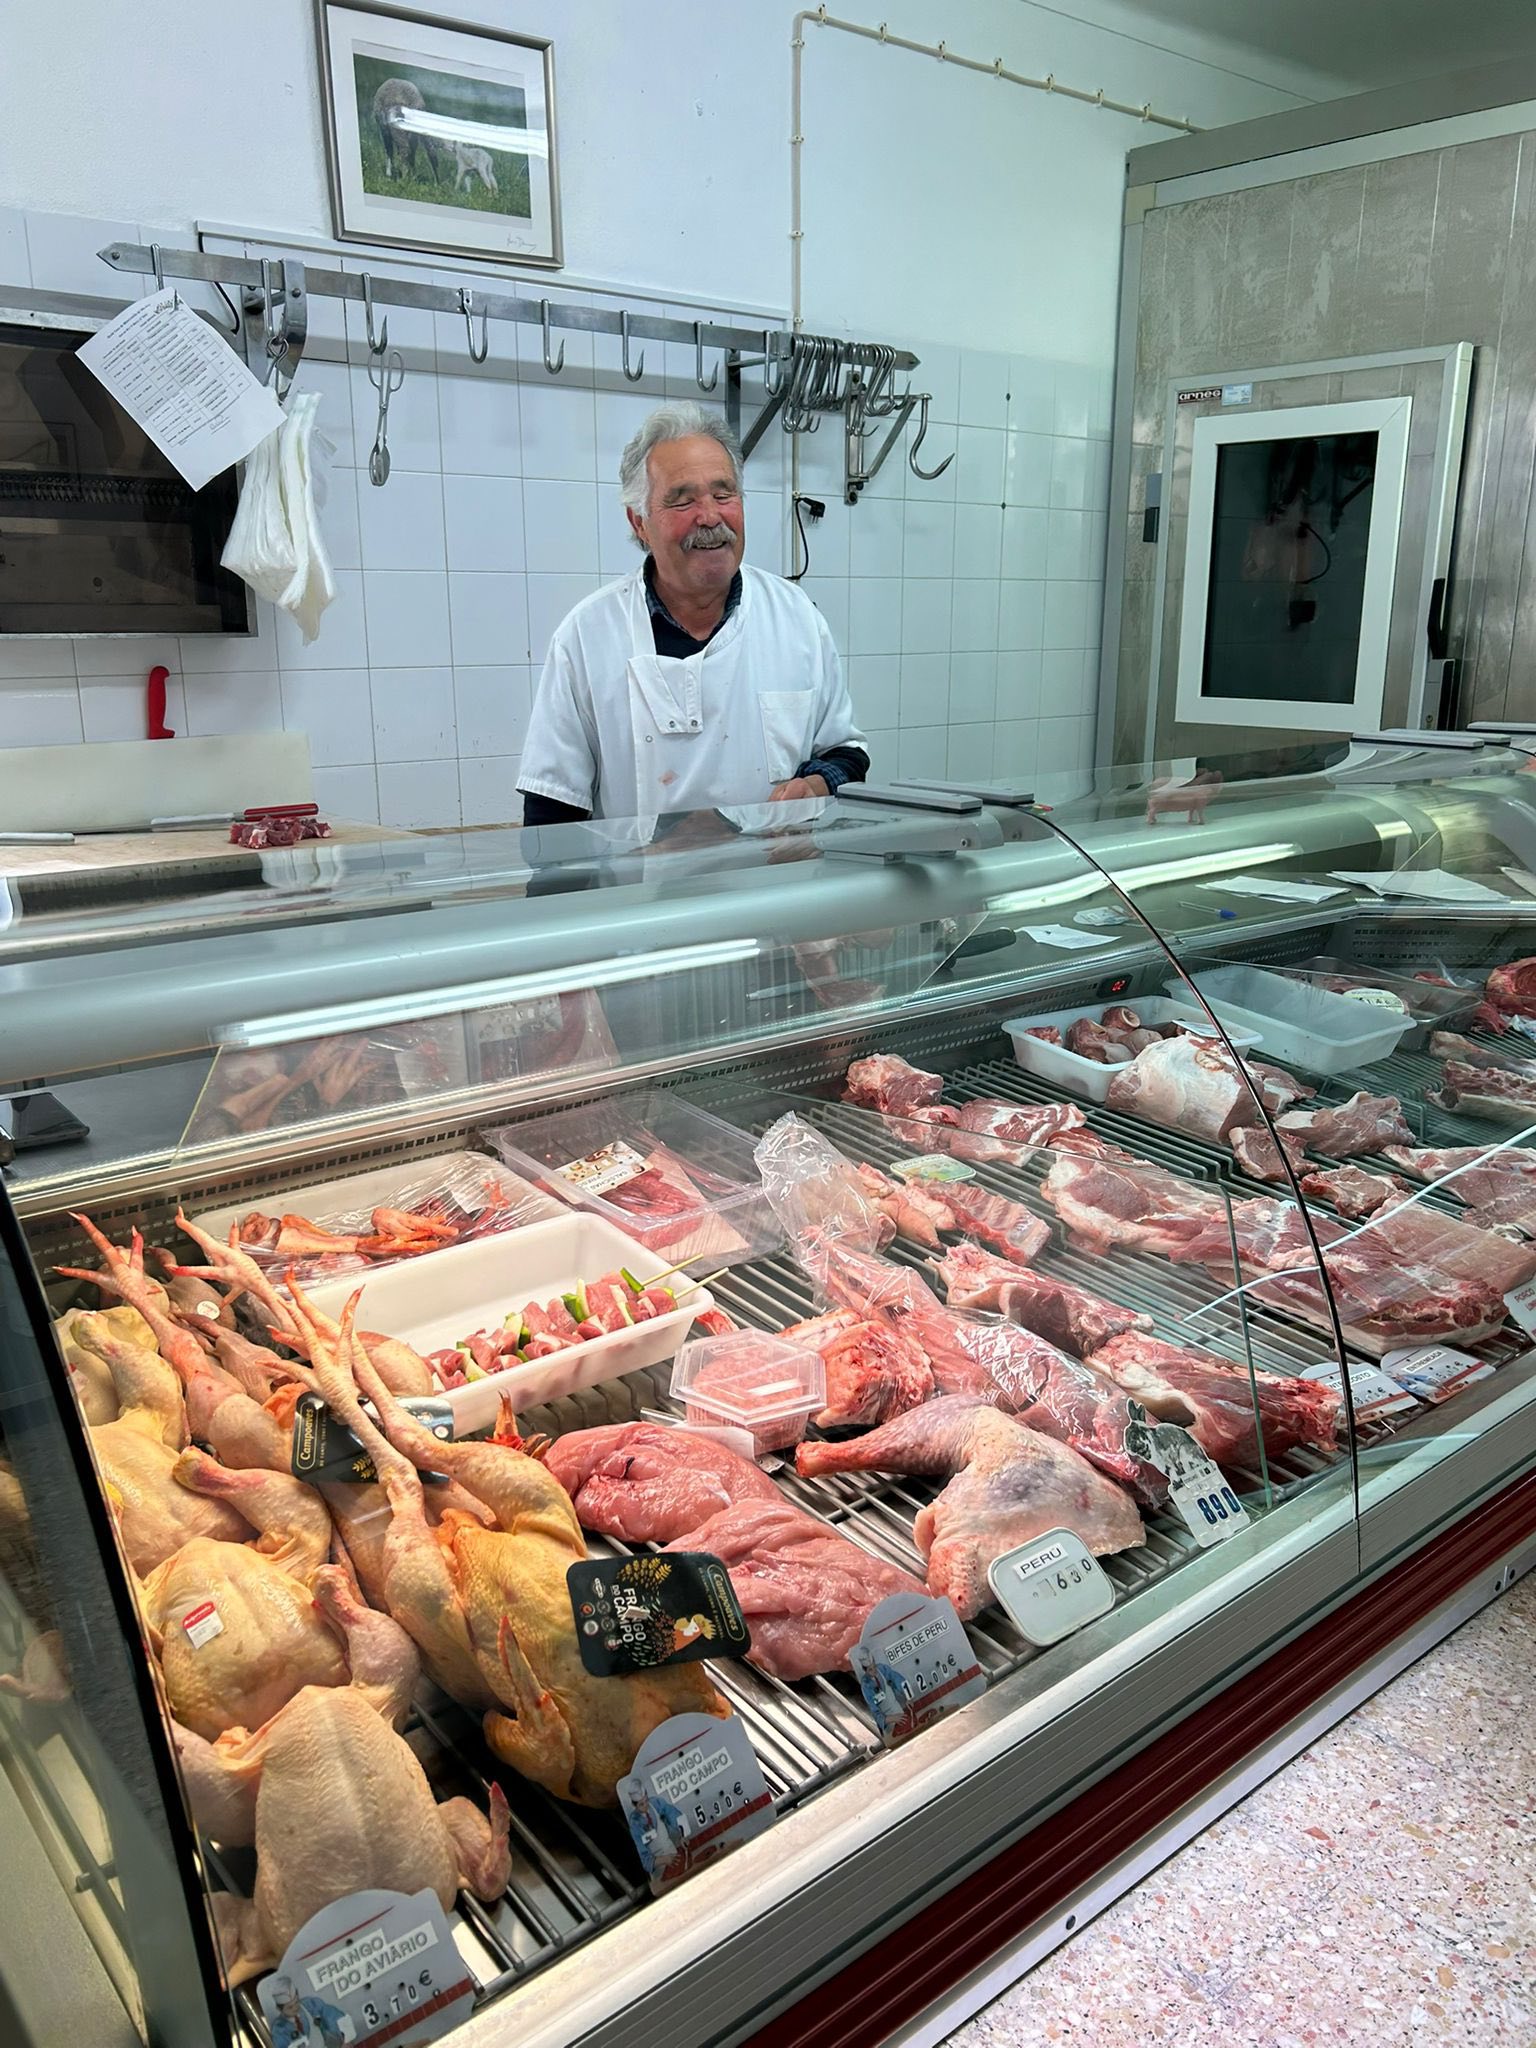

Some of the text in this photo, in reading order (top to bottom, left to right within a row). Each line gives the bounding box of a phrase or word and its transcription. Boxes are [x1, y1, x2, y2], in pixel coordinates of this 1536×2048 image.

[300, 1408, 314, 1461] Campoaves
[1197, 1487, 1241, 1525] 890
[611, 1584, 635, 1644] DO CAMPO
[623, 1587, 647, 1642] FRNGO
[713, 1573, 739, 1632] Campoaves
[887, 1619, 949, 1662] BIFES DE PERU
[656, 1751, 703, 1789] FRANGO
[669, 1752, 729, 1800] DO CAMPO
[315, 1935, 385, 1984] FRANGO
[336, 1971, 362, 1993] DO
